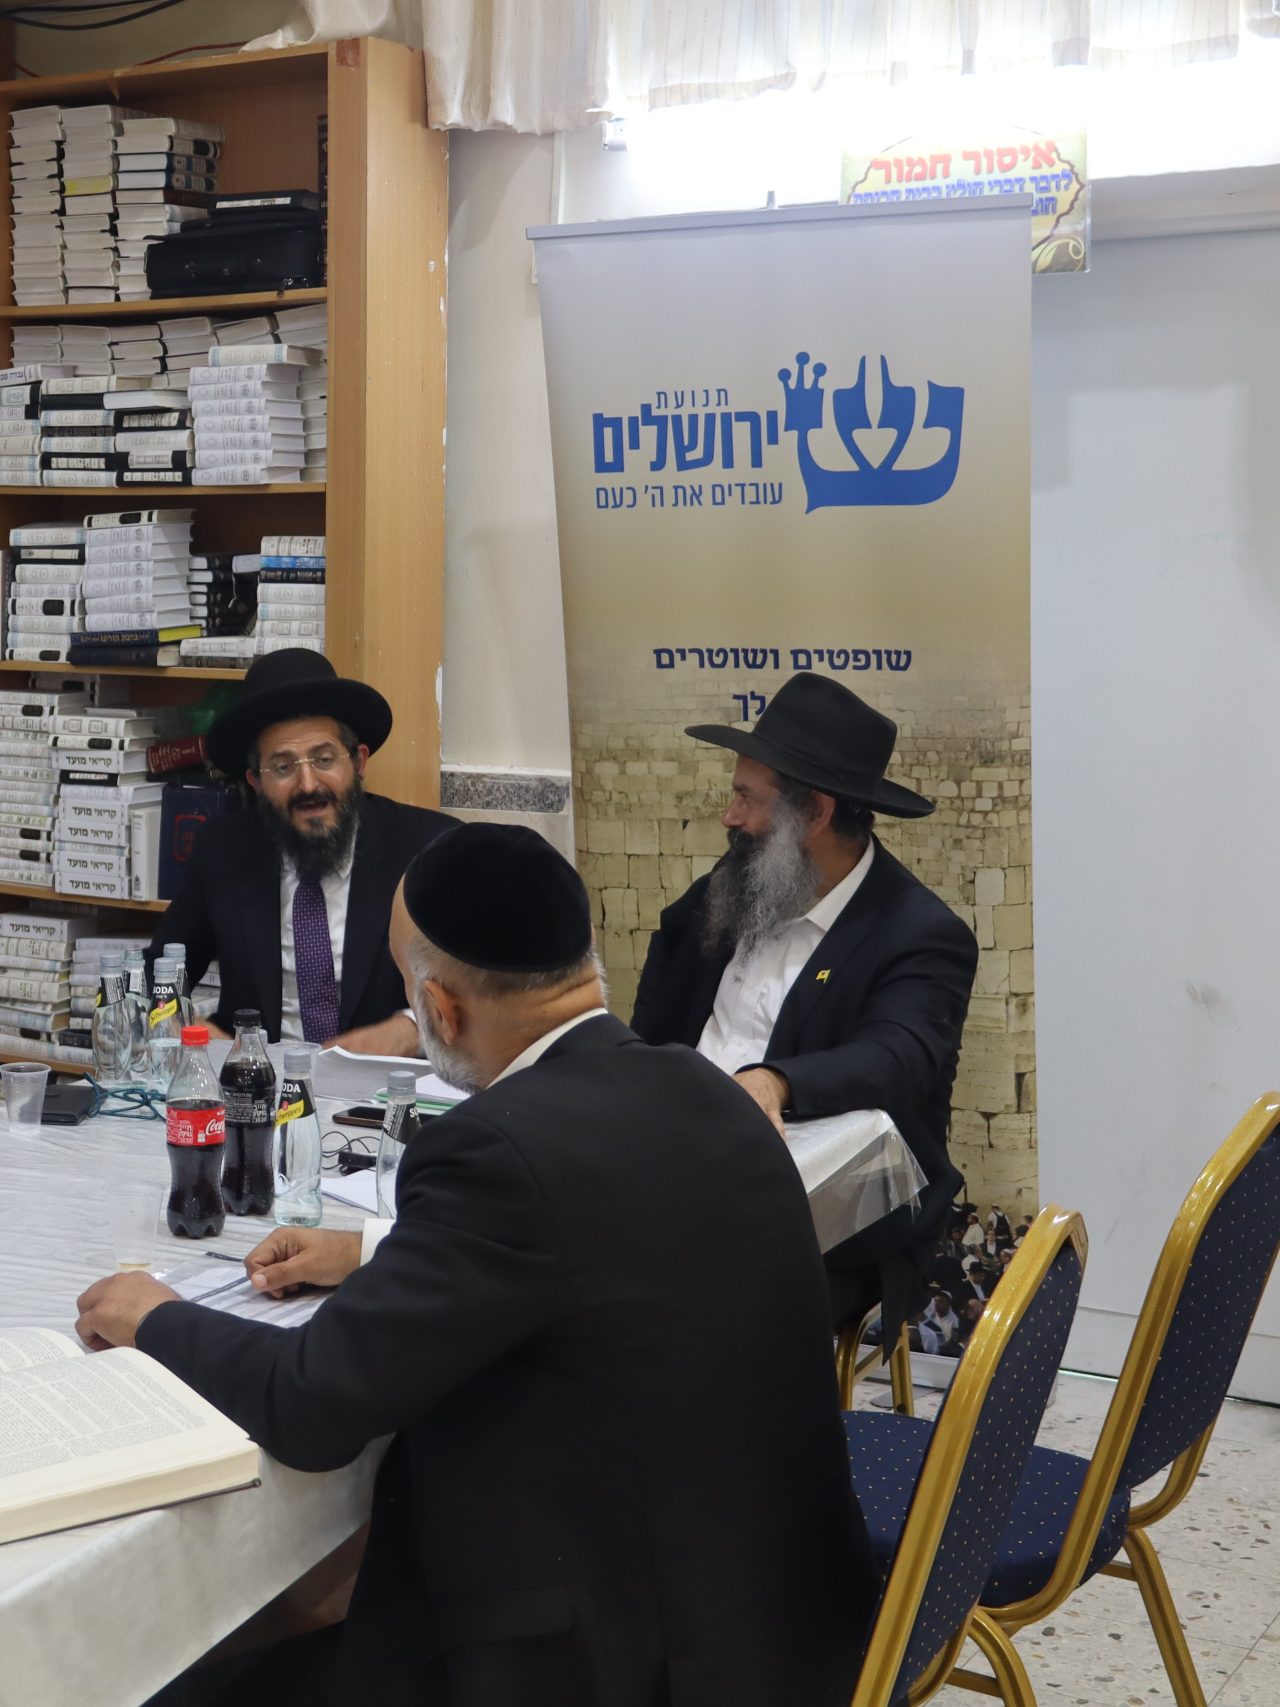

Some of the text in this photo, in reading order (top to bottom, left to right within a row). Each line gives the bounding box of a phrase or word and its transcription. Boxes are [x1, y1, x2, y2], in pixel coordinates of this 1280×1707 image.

[871, 140, 1057, 184] איסור חמור
[989, 177, 1024, 194] דברי
[1029, 169, 1072, 192] לדבר
[656, 388, 729, 409] תנועת
[592, 404, 779, 474] ירושלים
[596, 482, 782, 510] עובדים את ה' כעם
[653, 647, 912, 671] שופטים ושוטרים
[733, 690, 766, 721] לך
[66, 756, 112, 767] קריאי מועד
[72, 806, 116, 818] קריאי מועד
[68, 826, 113, 839] קריאי מועד
[68, 858, 113, 871] קריאי מועד
[69, 880, 116, 892] קריאי מועד
[10, 923, 55, 936] קריאי מועד
[282, 1084, 301, 1092] ODA
